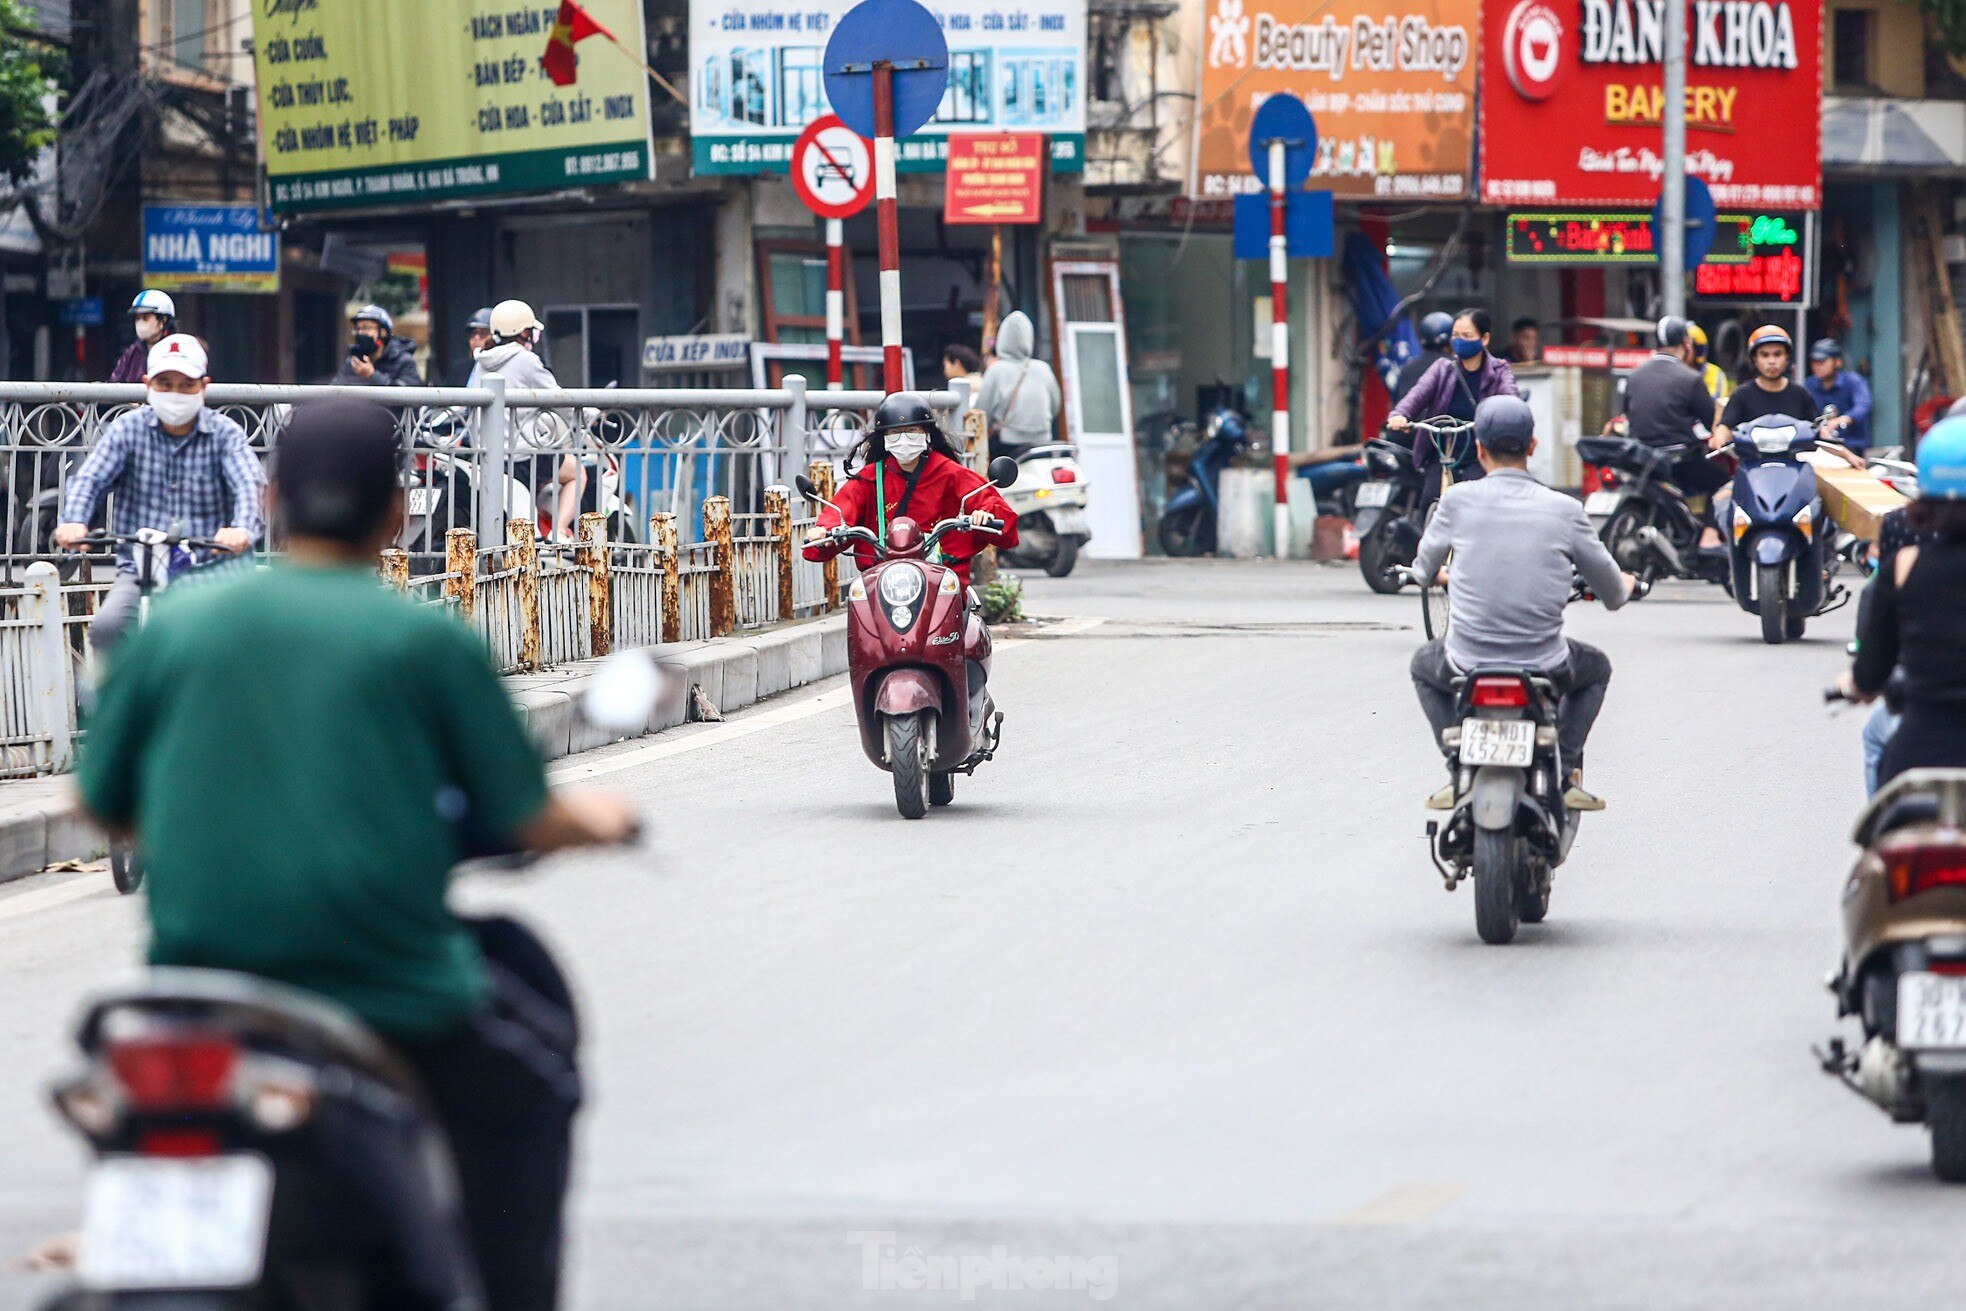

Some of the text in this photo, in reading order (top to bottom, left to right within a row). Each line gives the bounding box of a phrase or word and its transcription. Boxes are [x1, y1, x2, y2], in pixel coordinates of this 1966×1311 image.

[1255, 13, 1349, 81] Beauty
[1352, 15, 1397, 71] Pet
[1399, 15, 1468, 81] Shop
[1694, 1, 1798, 69] KHOA
[1606, 84, 1737, 122] BAKERY
